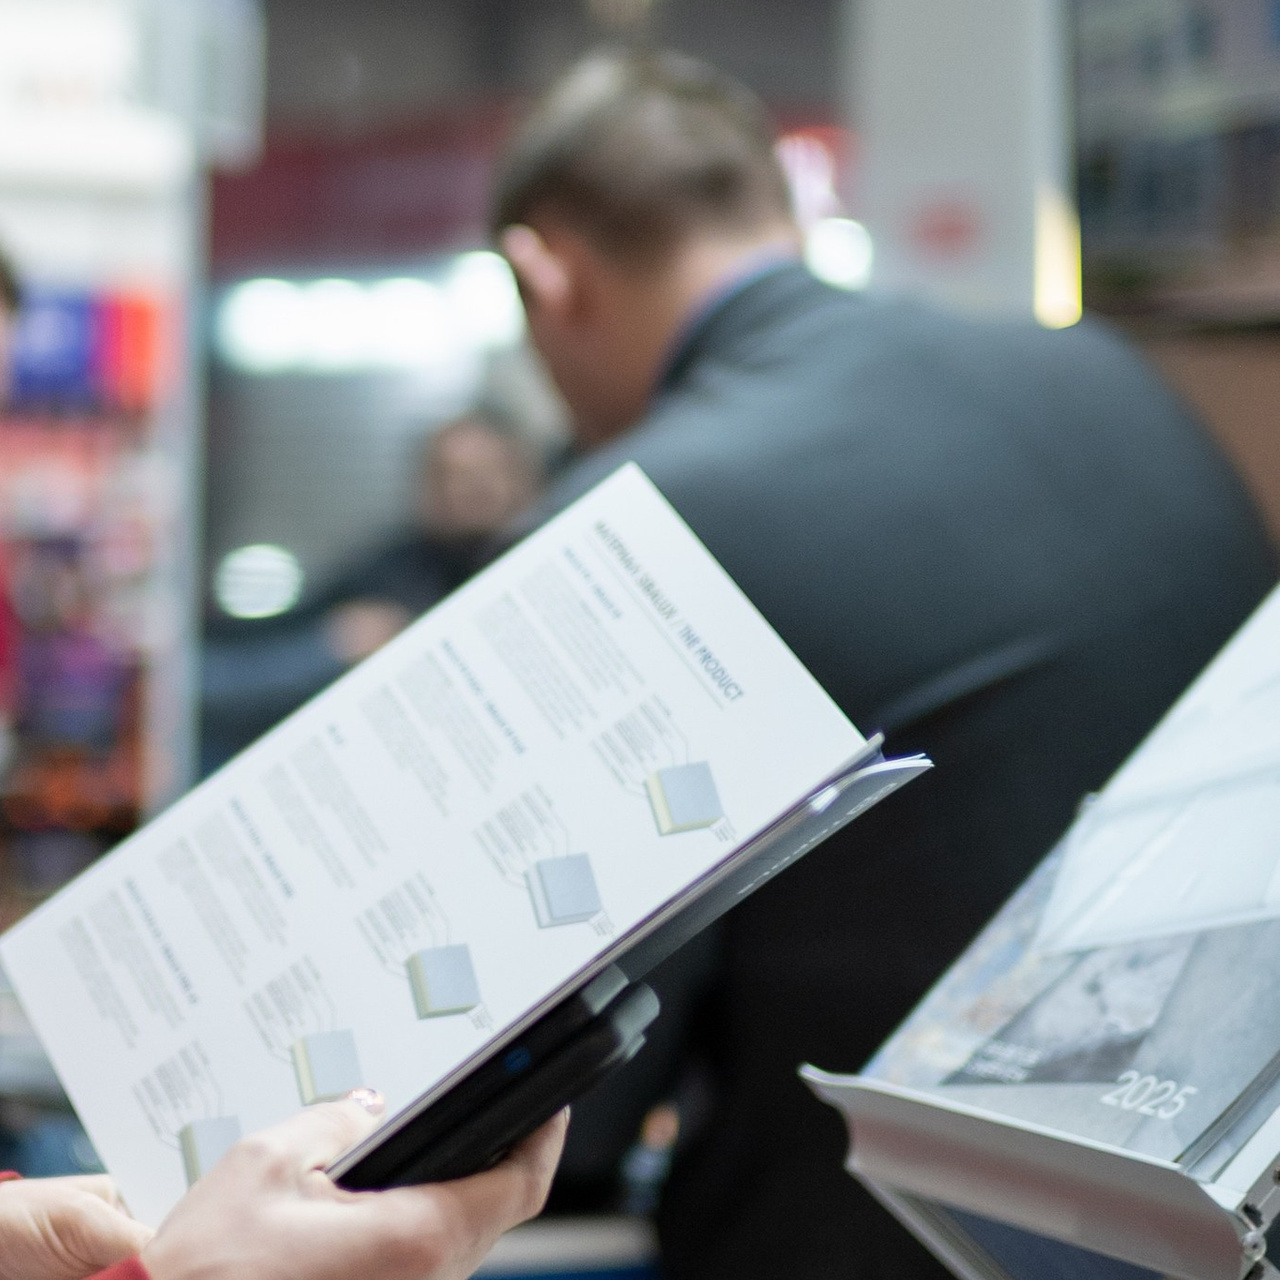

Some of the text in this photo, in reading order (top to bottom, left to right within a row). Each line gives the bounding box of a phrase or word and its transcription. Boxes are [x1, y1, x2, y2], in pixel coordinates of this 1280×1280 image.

[675, 622, 703, 650] THE
[692, 643, 746, 704] PRODUCT
[1101, 1069, 1197, 1120] 2025
